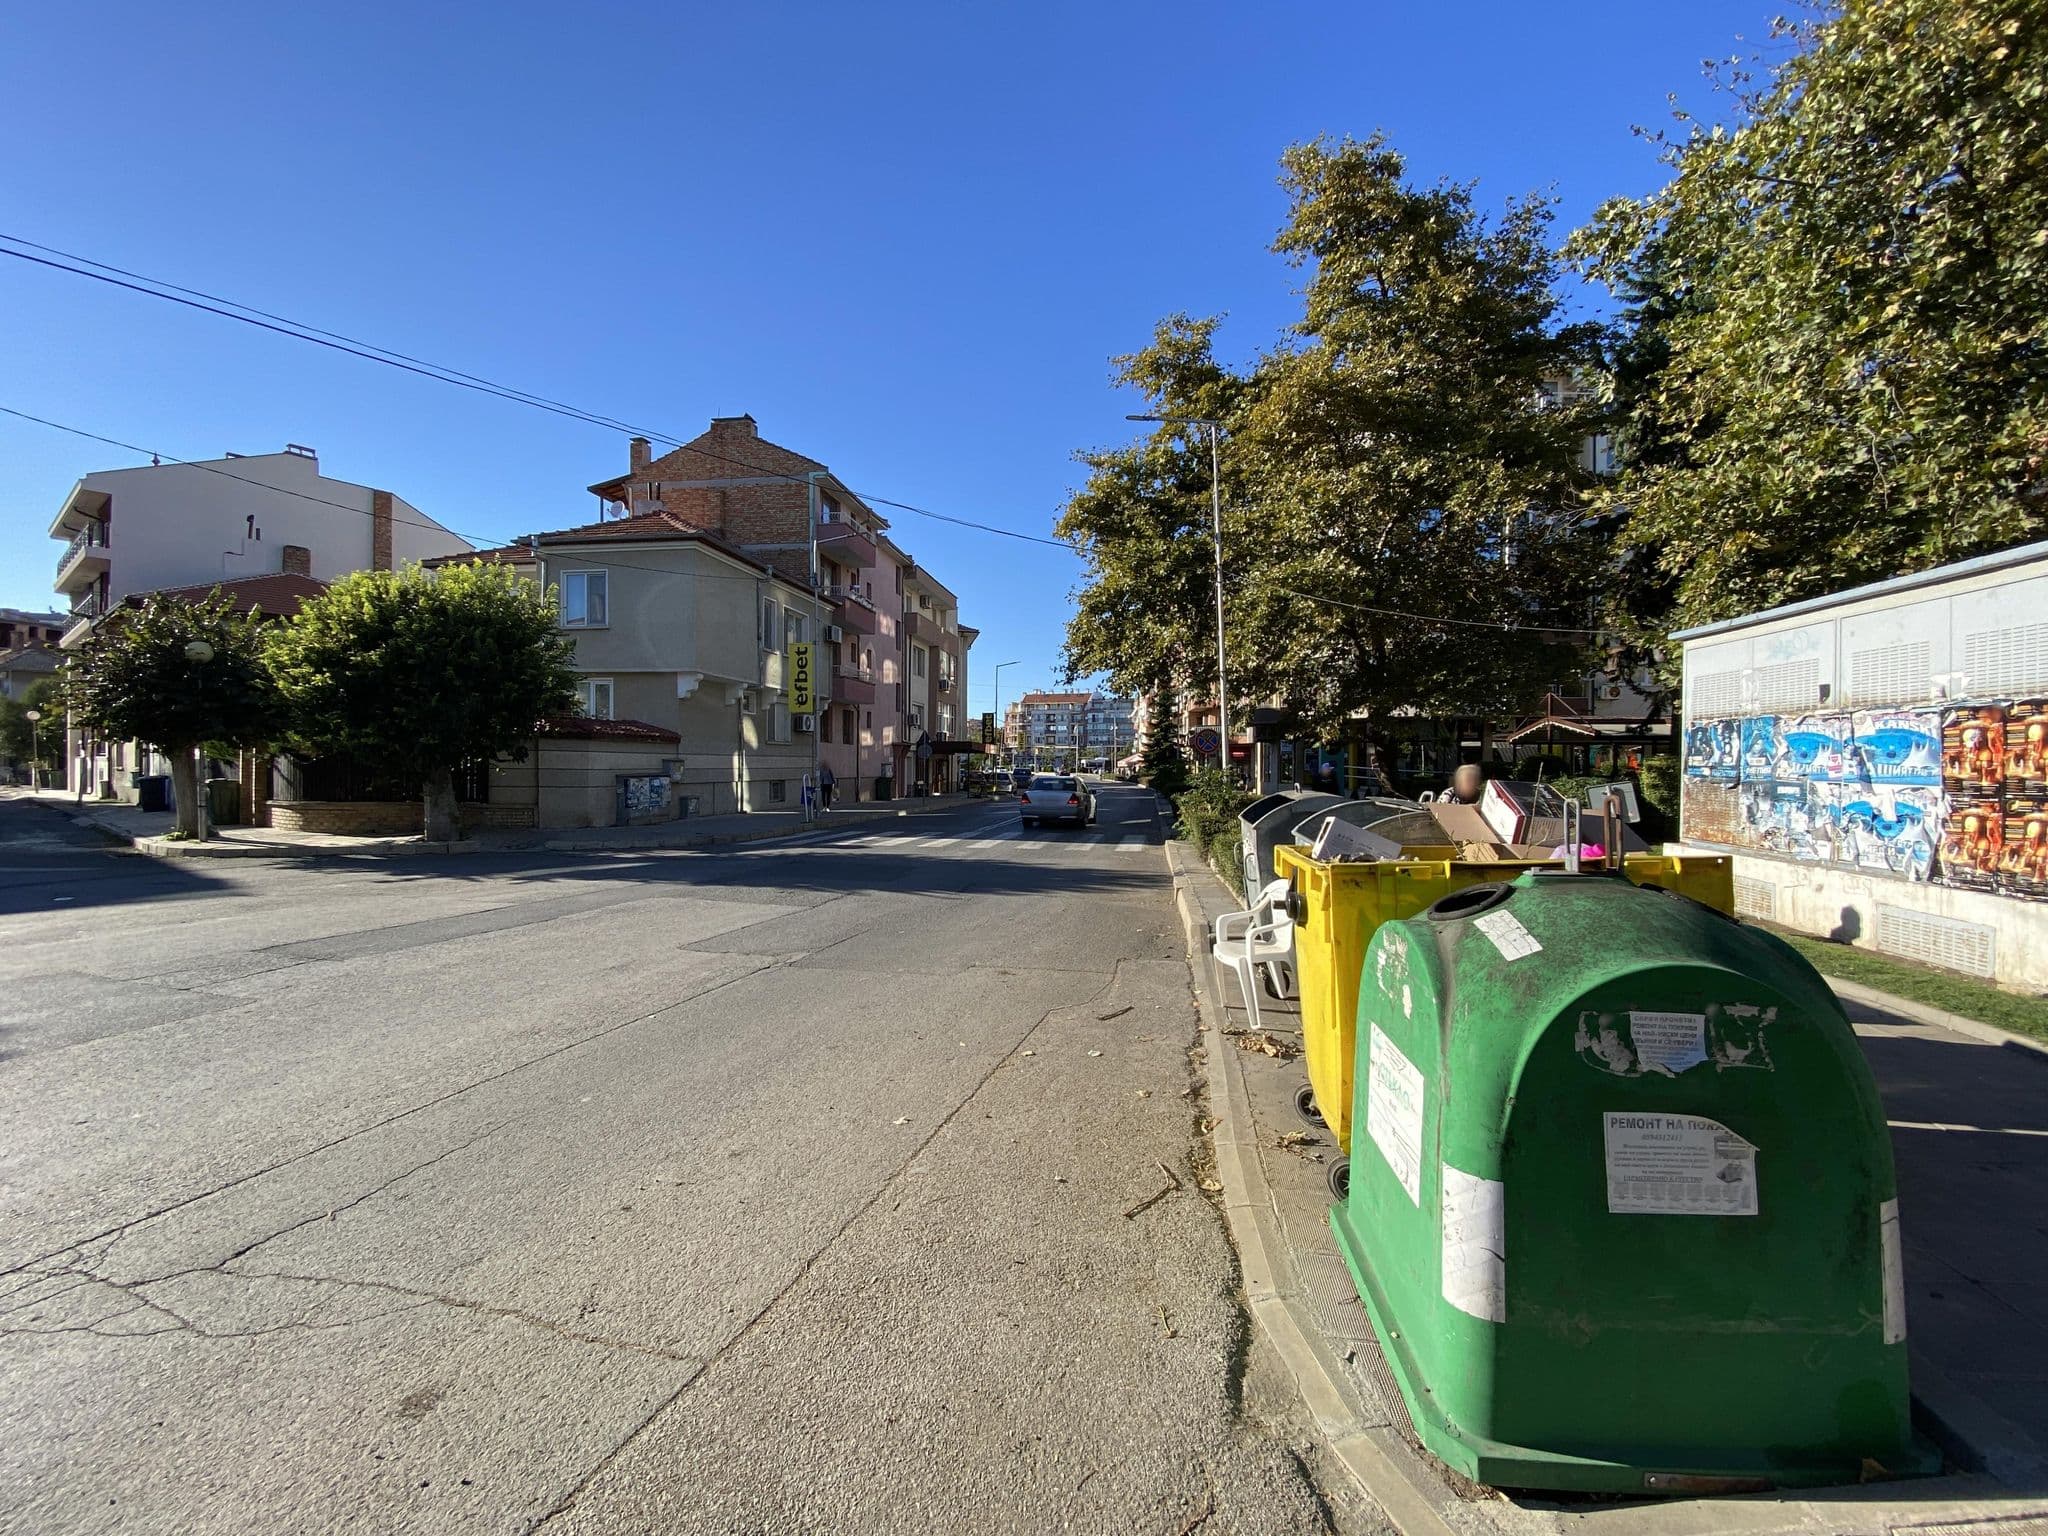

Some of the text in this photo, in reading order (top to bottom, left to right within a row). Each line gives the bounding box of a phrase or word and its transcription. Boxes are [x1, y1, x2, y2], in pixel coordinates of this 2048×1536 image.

[795, 646, 808, 706] efbet
[1610, 1117, 1661, 1130] РЕМОНТ
[1665, 1118, 1684, 1130] НА
